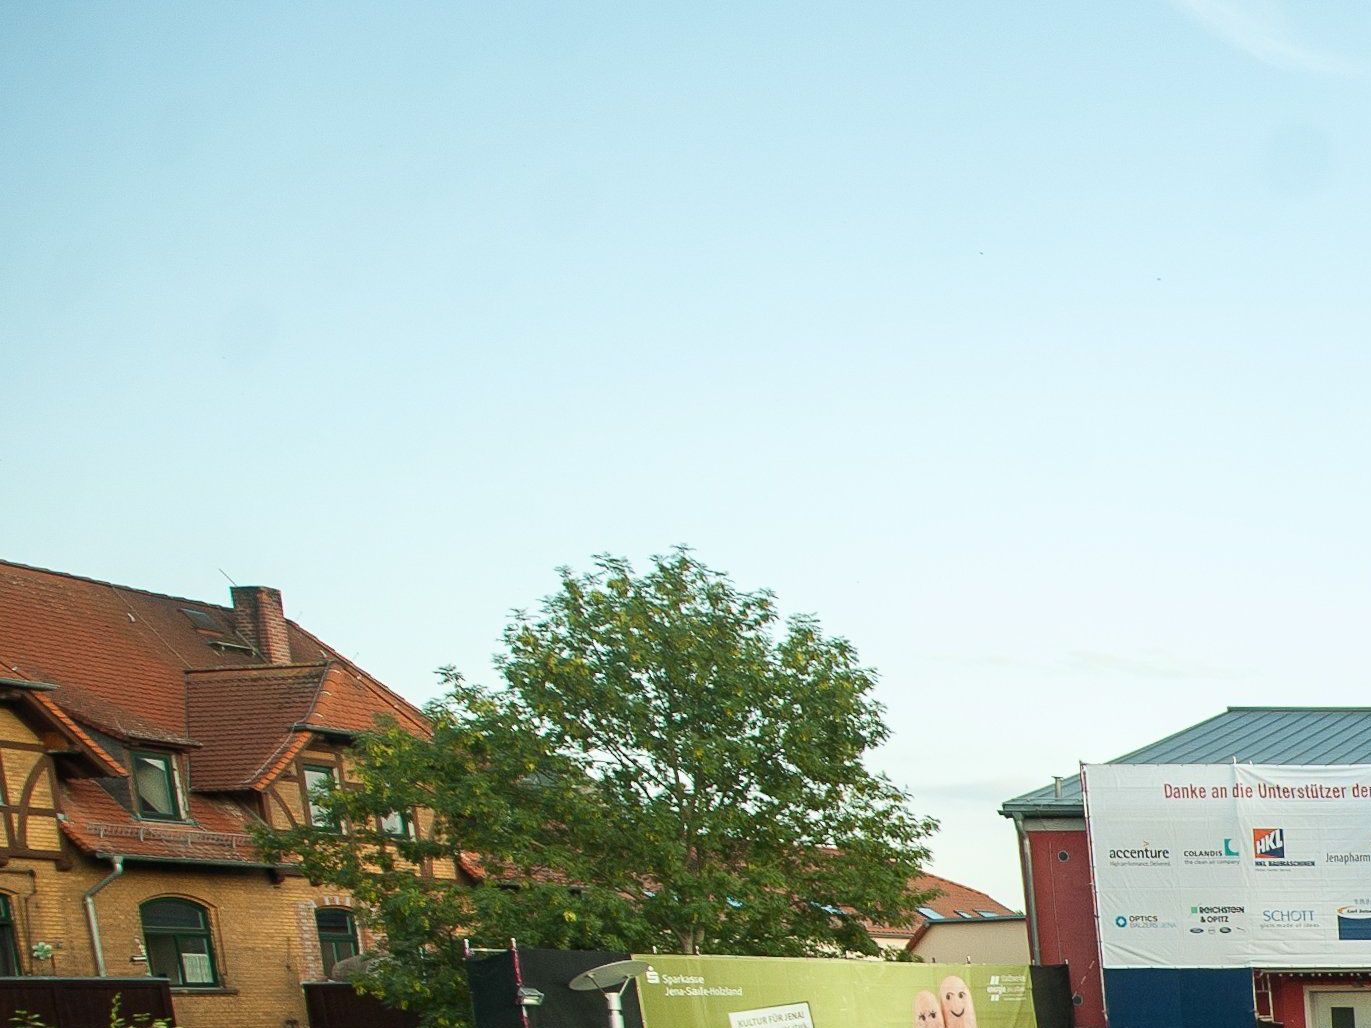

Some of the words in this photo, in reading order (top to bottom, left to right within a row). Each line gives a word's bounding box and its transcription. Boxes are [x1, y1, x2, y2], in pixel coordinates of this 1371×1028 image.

[1164, 783, 1207, 799] Danke
[1211, 786, 1228, 799] an
[1232, 783, 1253, 799] die
[1258, 782, 1347, 799] Unterstützer
[1256, 828, 1283, 855] HKL
[1109, 847, 1170, 859] accenture
[1325, 852, 1371, 864] Jenapharm
[1263, 910, 1315, 922] SCHOTT
[661, 974, 705, 985] Sparkasse
[737, 1015, 768, 1028] KULTUR
[768, 1012, 784, 1024] FÜR
[784, 1009, 806, 1022] JENA!
